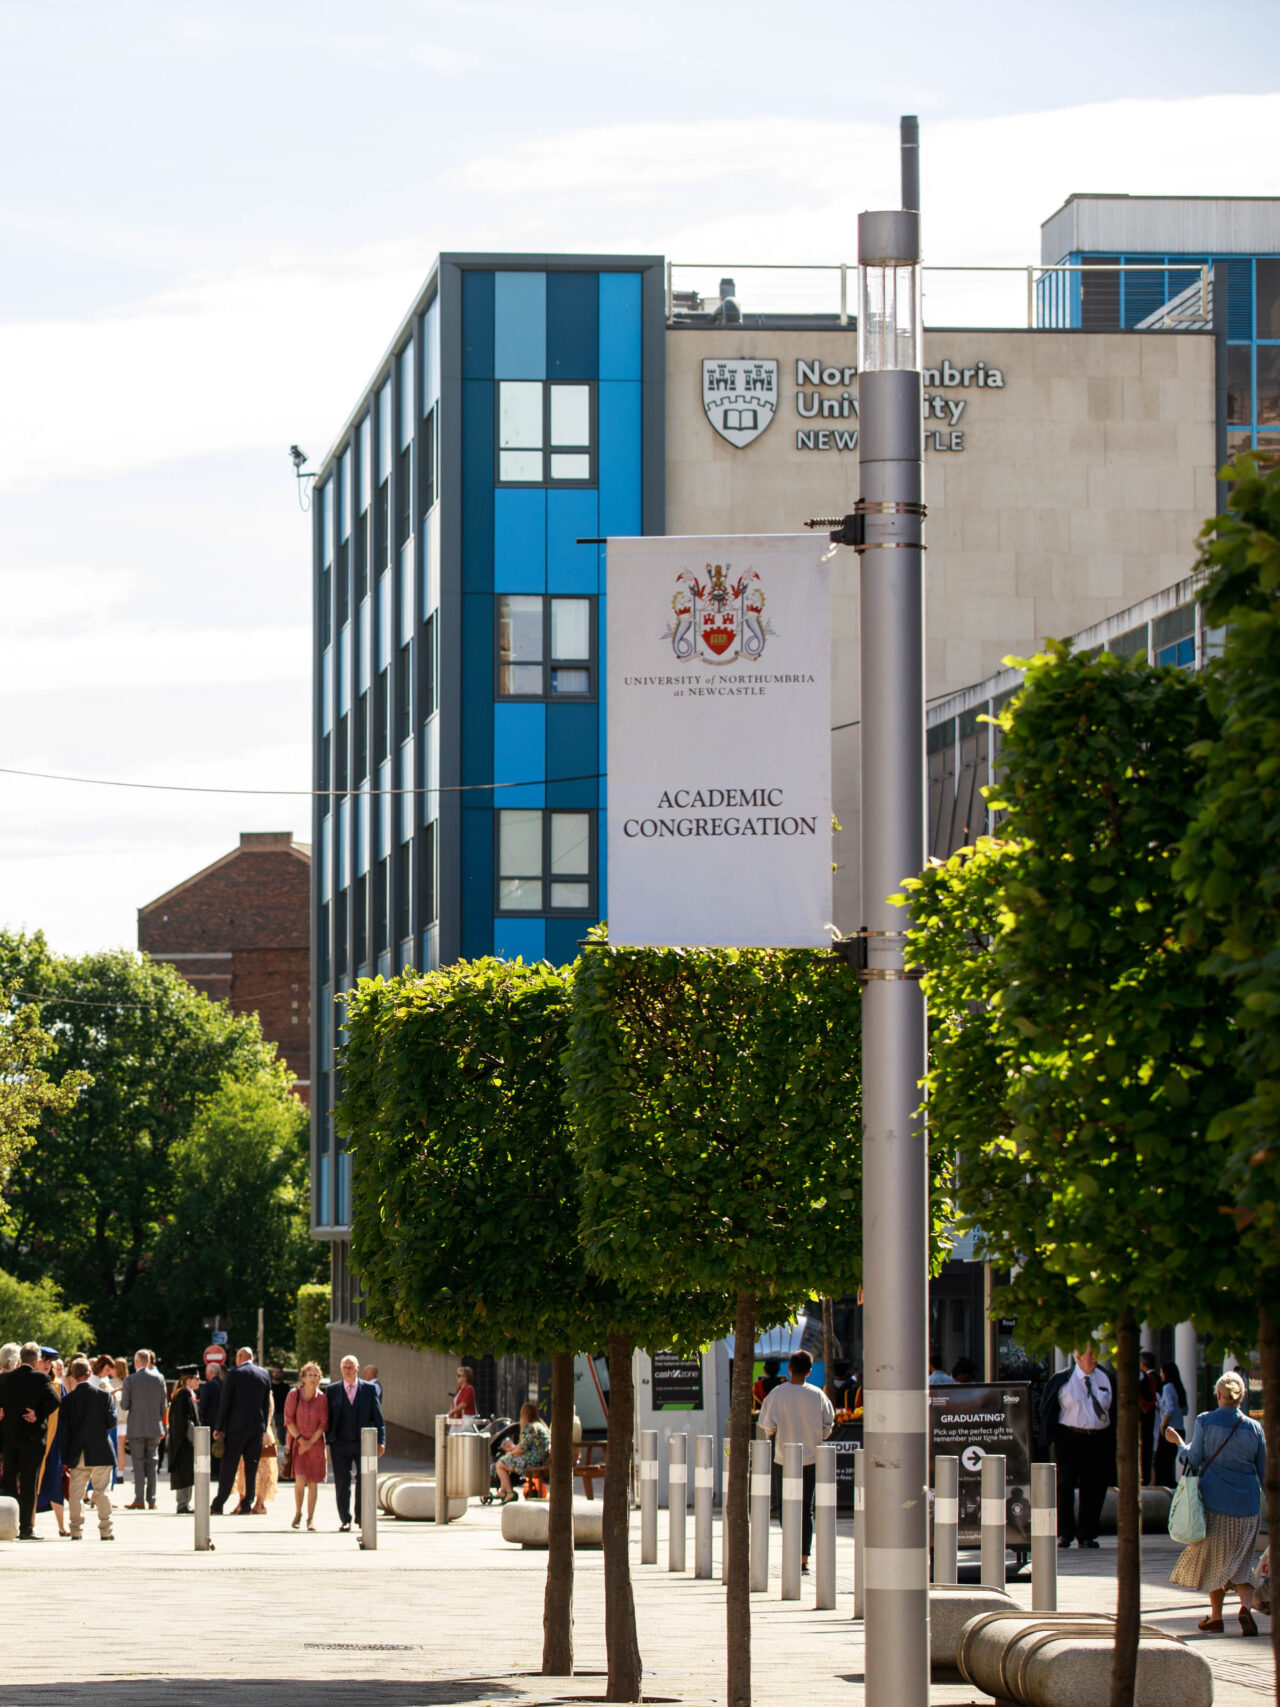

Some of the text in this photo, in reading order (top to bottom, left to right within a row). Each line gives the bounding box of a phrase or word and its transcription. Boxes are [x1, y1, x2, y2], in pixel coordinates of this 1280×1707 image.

[796, 358, 1005, 389] Normbria
[796, 390, 968, 427] Uniity
[624, 674, 816, 686] UNIVERSITY of NORTHUMBRIA
[673, 686, 767, 697] at NEWCASTLE
[657, 787, 783, 809] ACADEMIC
[623, 816, 818, 839] CONGREGATION
[1003, 1395, 1020, 1403] Shop
[940, 1413, 1005, 1423] GRADUATING?
[970, 1427, 993, 1436] perfect
[994, 1426, 1004, 1435] gift
